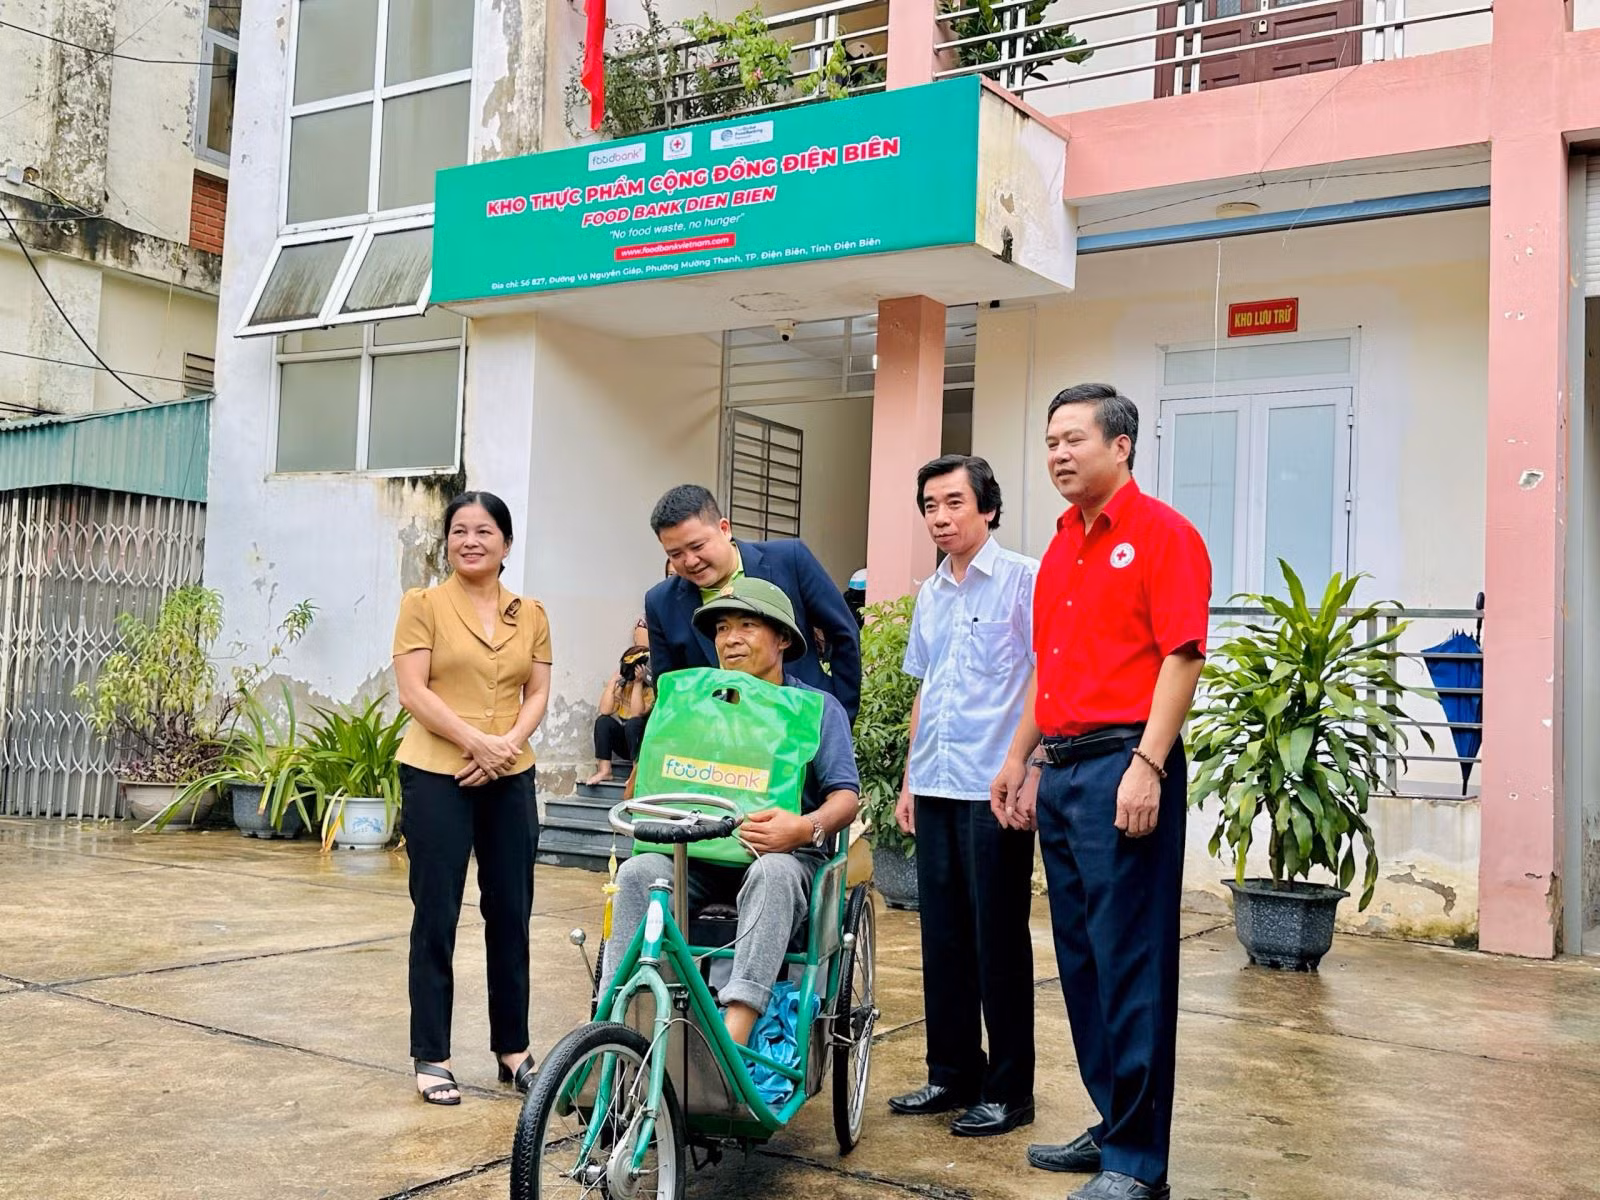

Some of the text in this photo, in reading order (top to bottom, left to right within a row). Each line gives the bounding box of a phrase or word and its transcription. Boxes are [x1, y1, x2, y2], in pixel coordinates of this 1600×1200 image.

[487, 135, 901, 218] KHO THỰC PHẨM CỘNG ĐỒNG ĐIỆN BIÊN
[581, 185, 778, 228] FOOD BANK DIEN BIEN
[628, 225, 652, 238] food
[688, 220, 702, 230] no
[620, 236, 730, 257] www.foodbankvietnam.com
[1234, 312, 1253, 328] KHO
